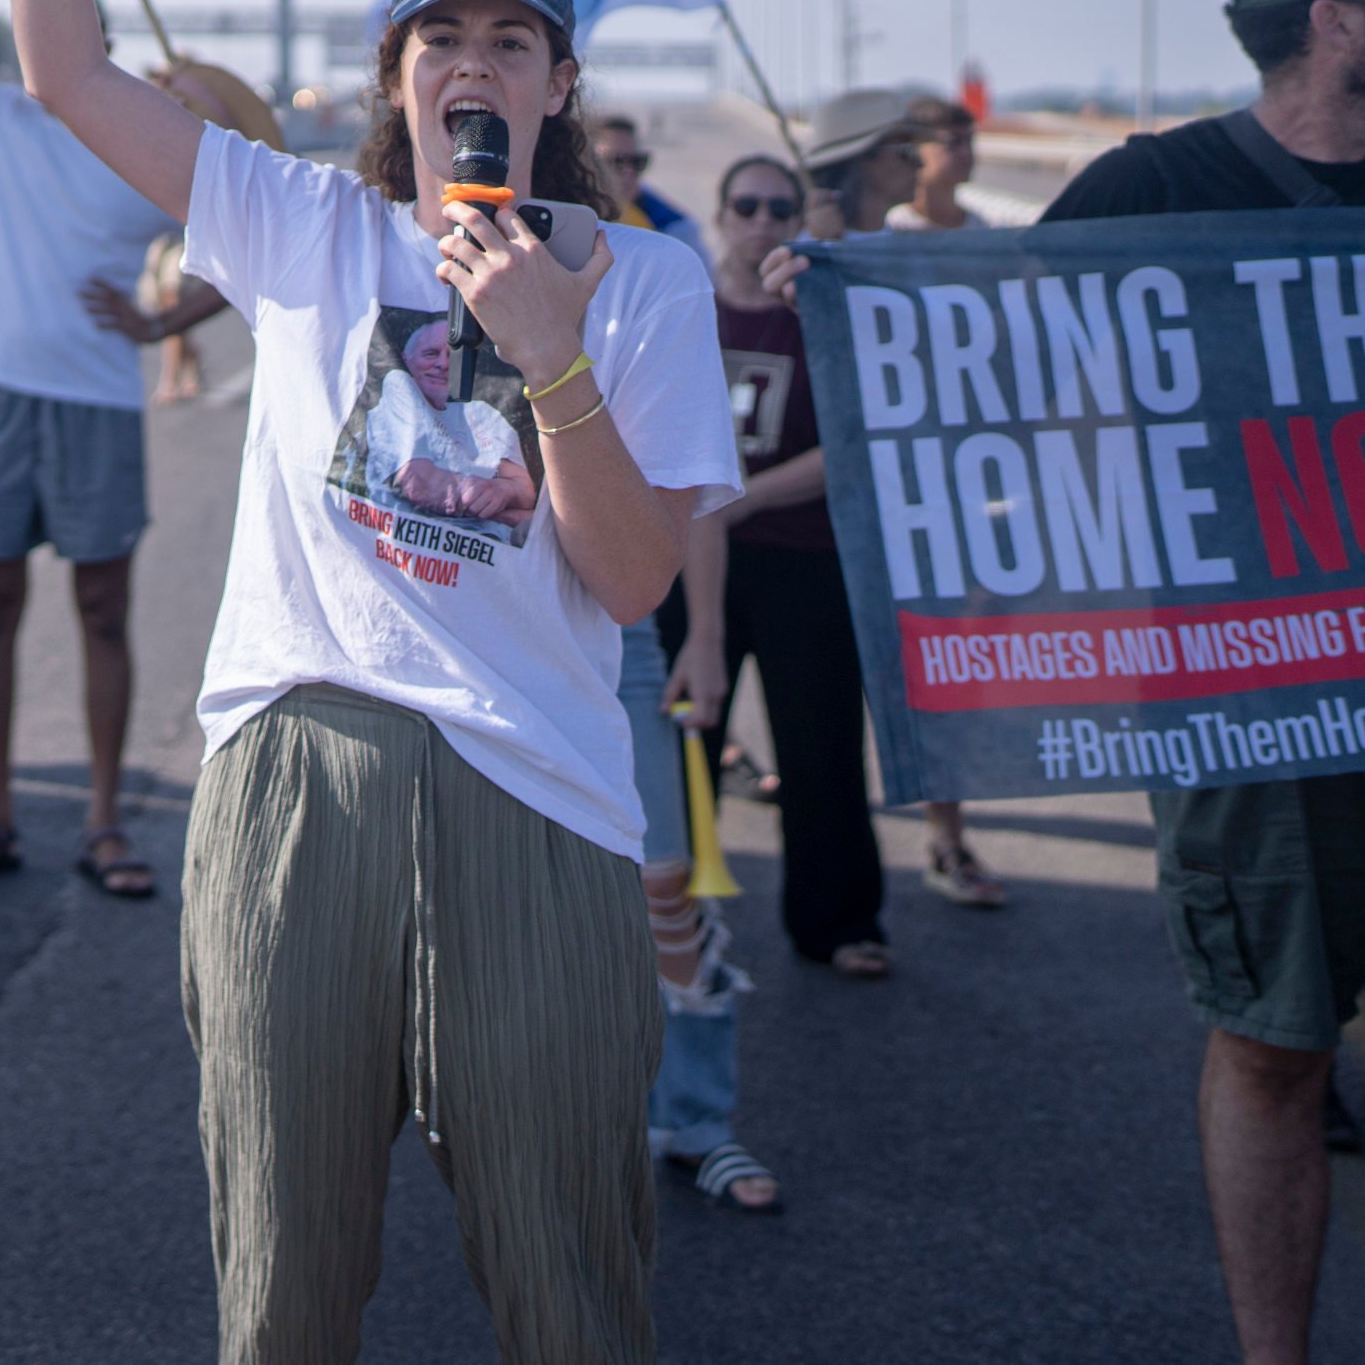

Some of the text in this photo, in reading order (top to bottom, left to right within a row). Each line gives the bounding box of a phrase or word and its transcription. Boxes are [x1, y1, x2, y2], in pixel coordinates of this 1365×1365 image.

[845, 265, 1202, 431] BRING
[348, 498, 495, 567] BRING KEITH SIEGEL
[867, 421, 1237, 601] HOME
[375, 538, 460, 588] BACK NOW!
[919, 628, 1097, 686] HOSTAGES
[1103, 625, 1175, 677] AND
[1179, 608, 1345, 674] MISSING
